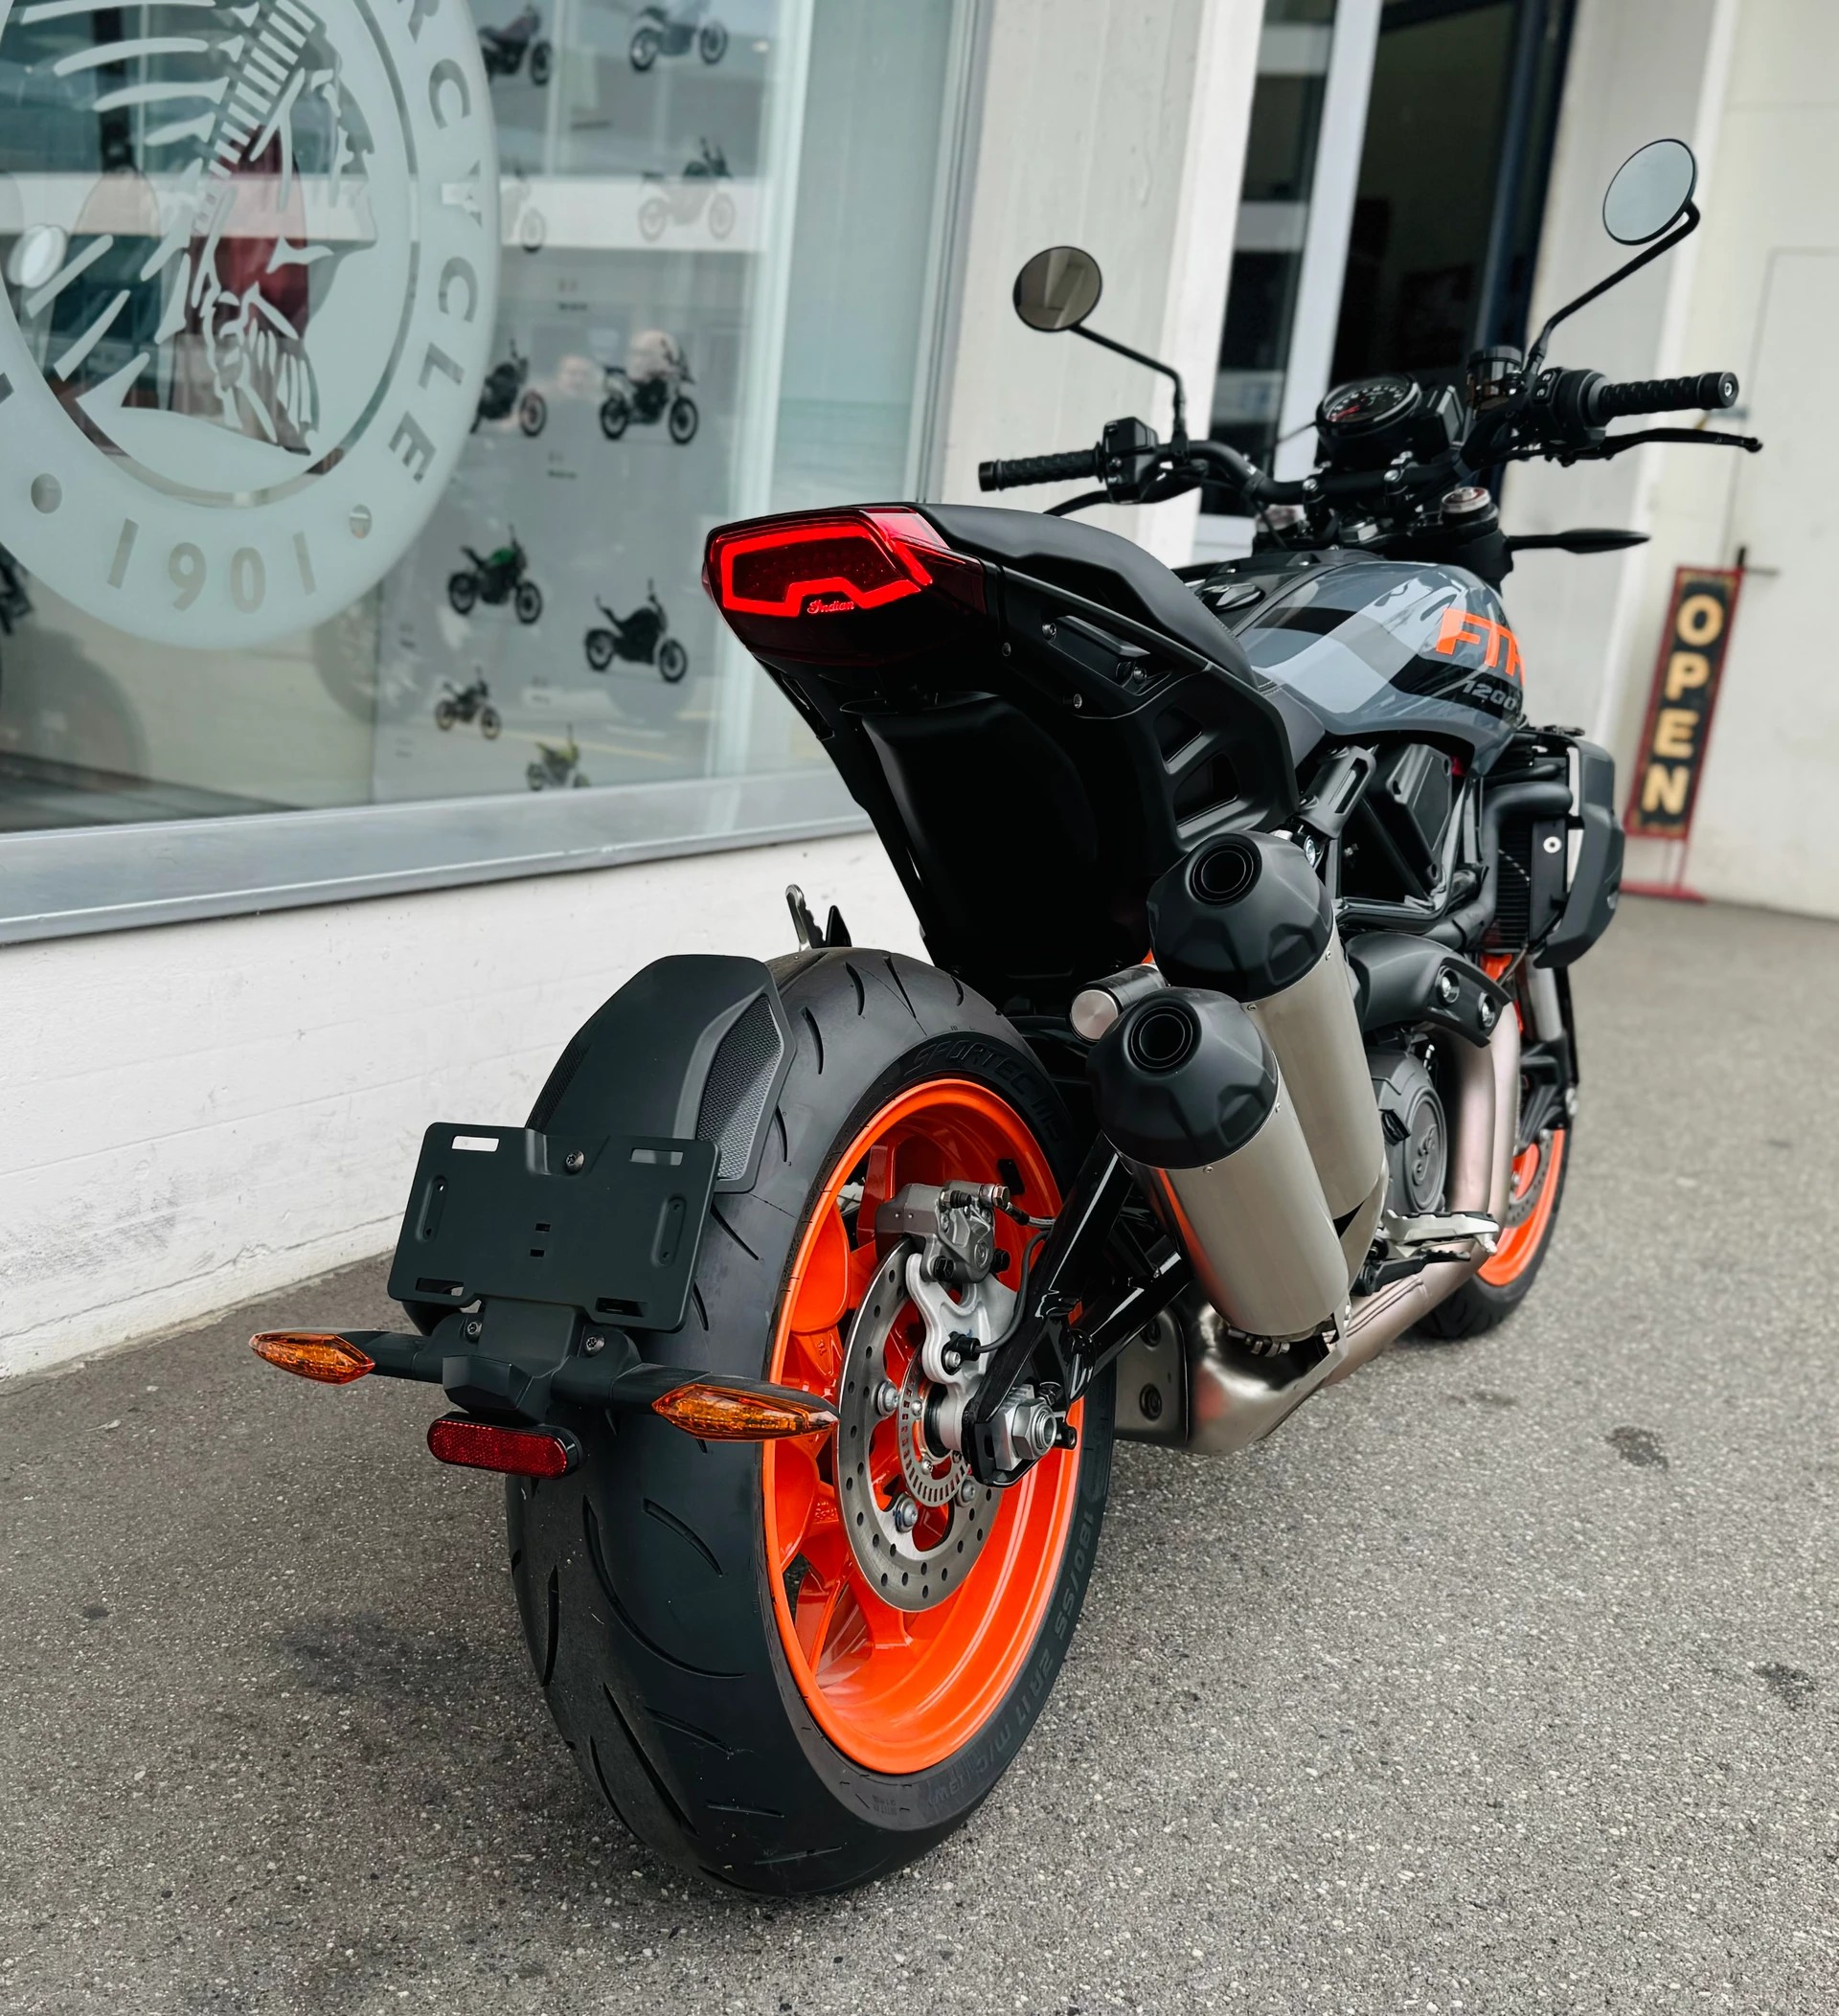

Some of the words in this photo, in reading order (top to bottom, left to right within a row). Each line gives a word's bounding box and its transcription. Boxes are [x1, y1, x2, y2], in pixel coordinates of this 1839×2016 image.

[107, 517, 317, 614] 1901
[806, 599, 855, 614] Indian
[1462, 679, 1518, 711] 1200
[1641, 593, 1724, 816] OPEN
[904, 1039, 1038, 1095] SPORTEC
